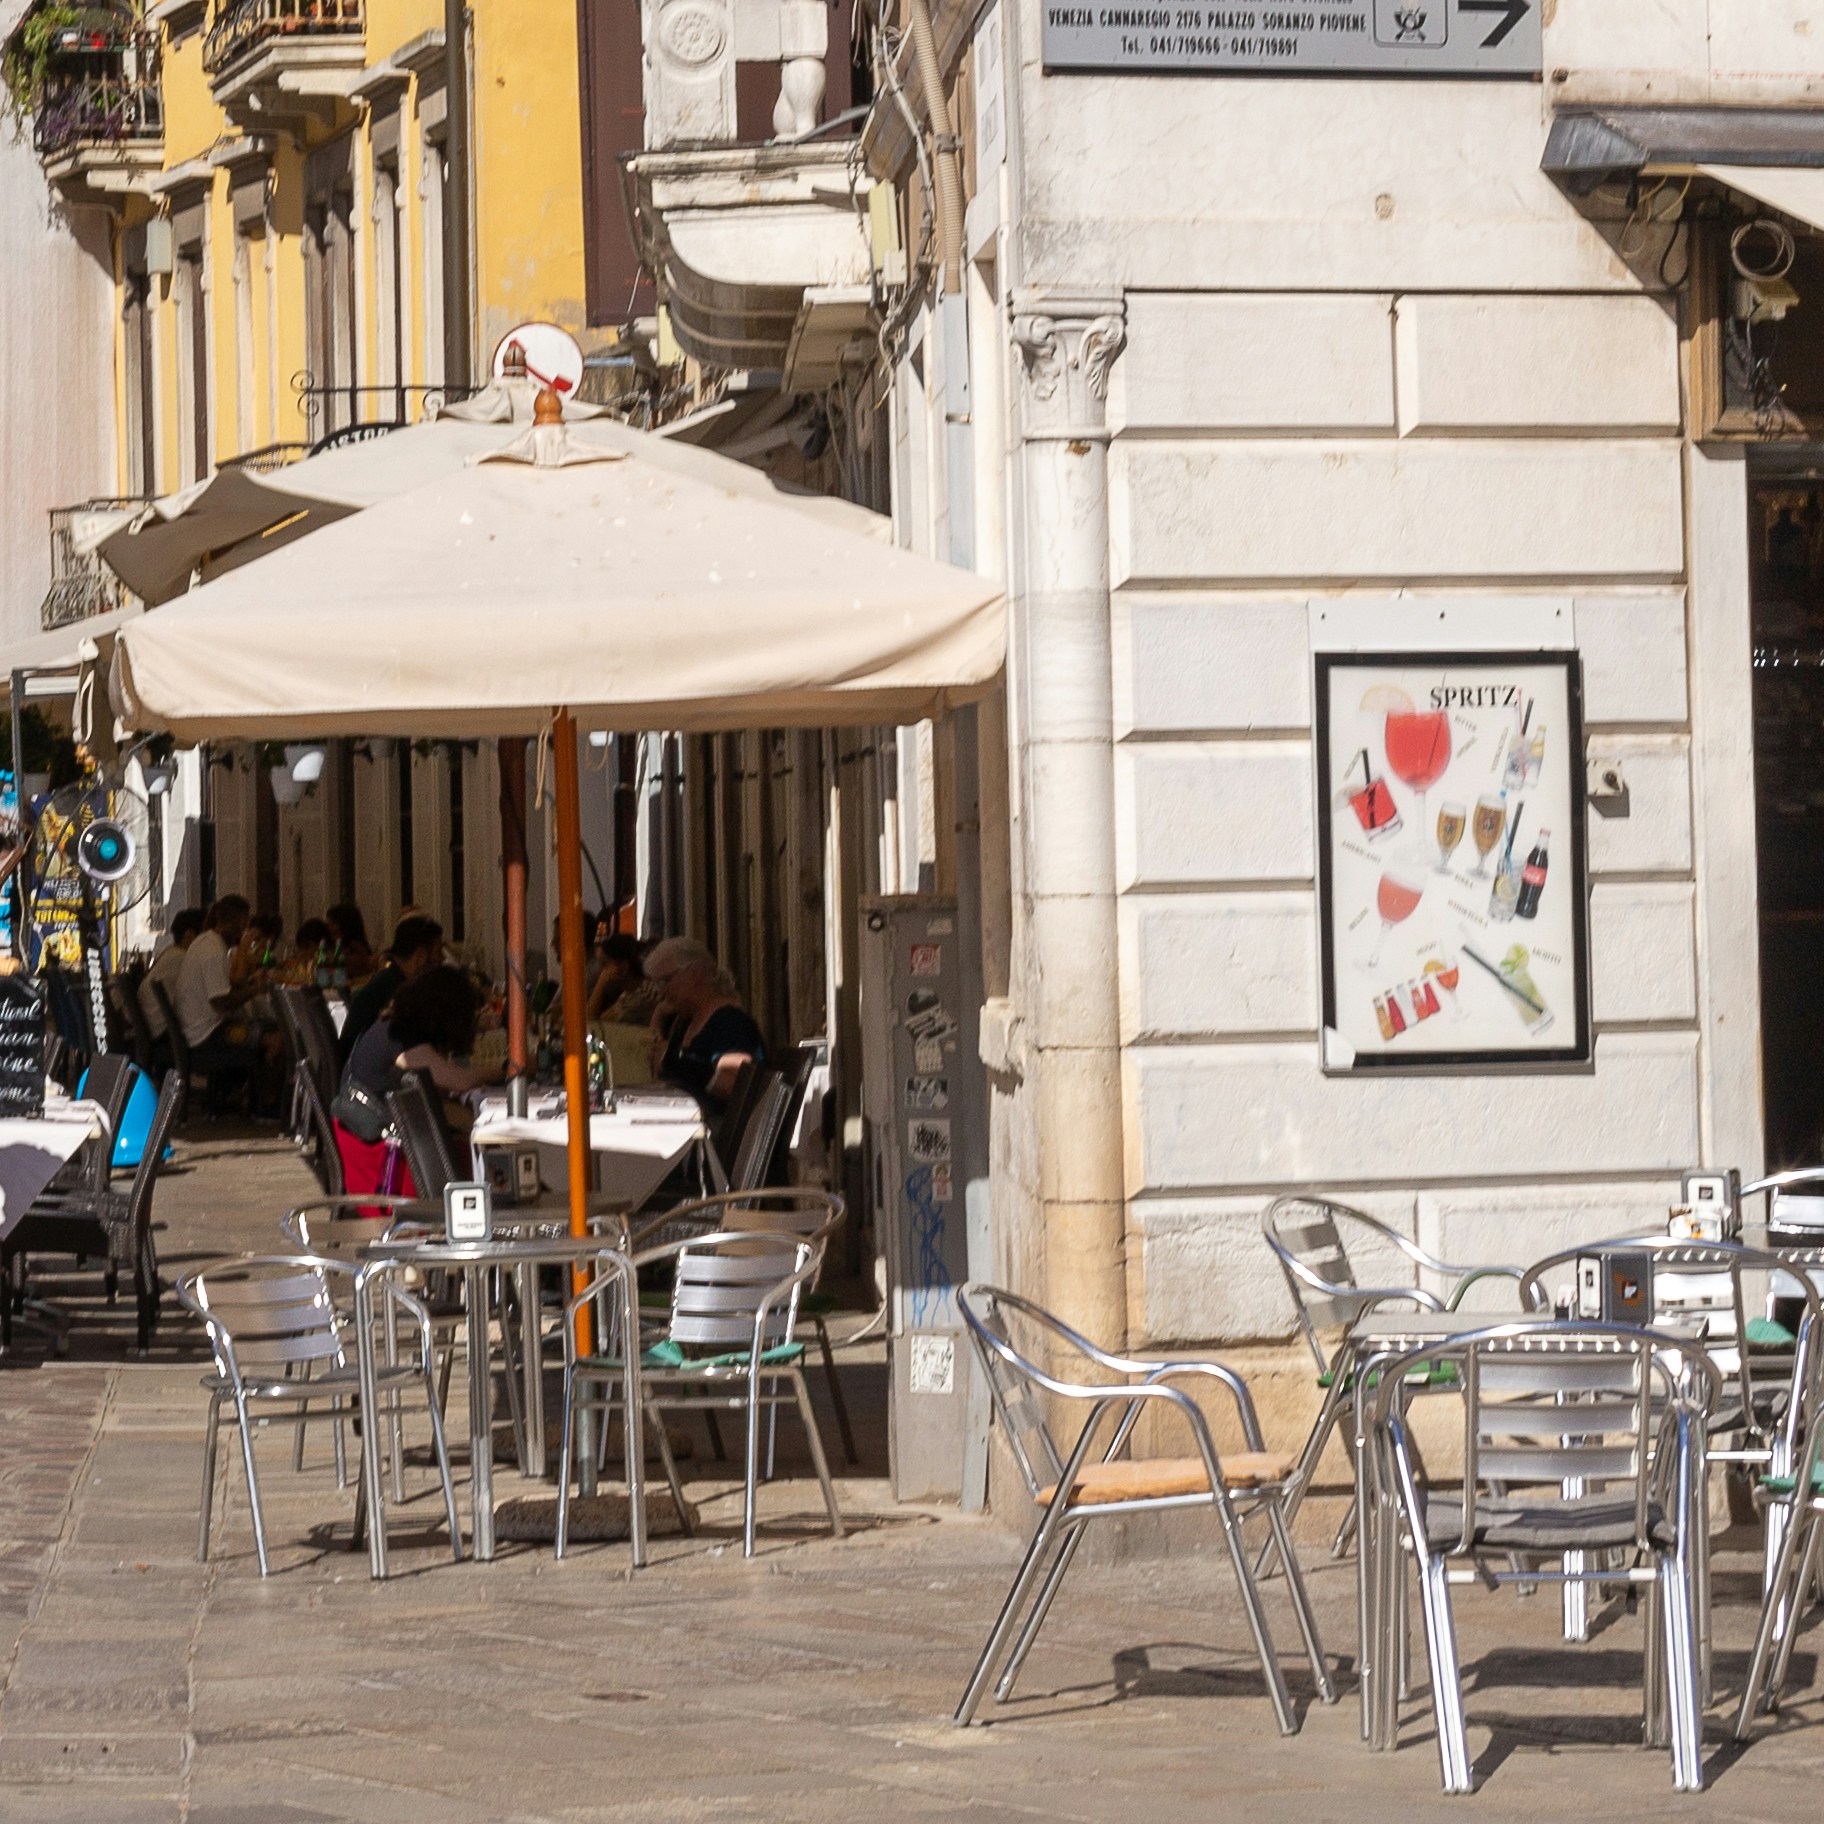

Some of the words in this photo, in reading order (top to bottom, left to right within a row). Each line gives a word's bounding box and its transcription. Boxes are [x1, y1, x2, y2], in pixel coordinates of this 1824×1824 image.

[1049, 8, 1094, 26] VENEZIA
[1101, 9, 1171, 29] CANNAREGIO
[1176, 10, 1202, 29] 2176
[1208, 11, 1256, 29] PALAZZO
[1262, 12, 1315, 31] SORANZO
[1319, 14, 1367, 33] PIOVENE
[1430, 684, 1518, 710] SPRITZ
